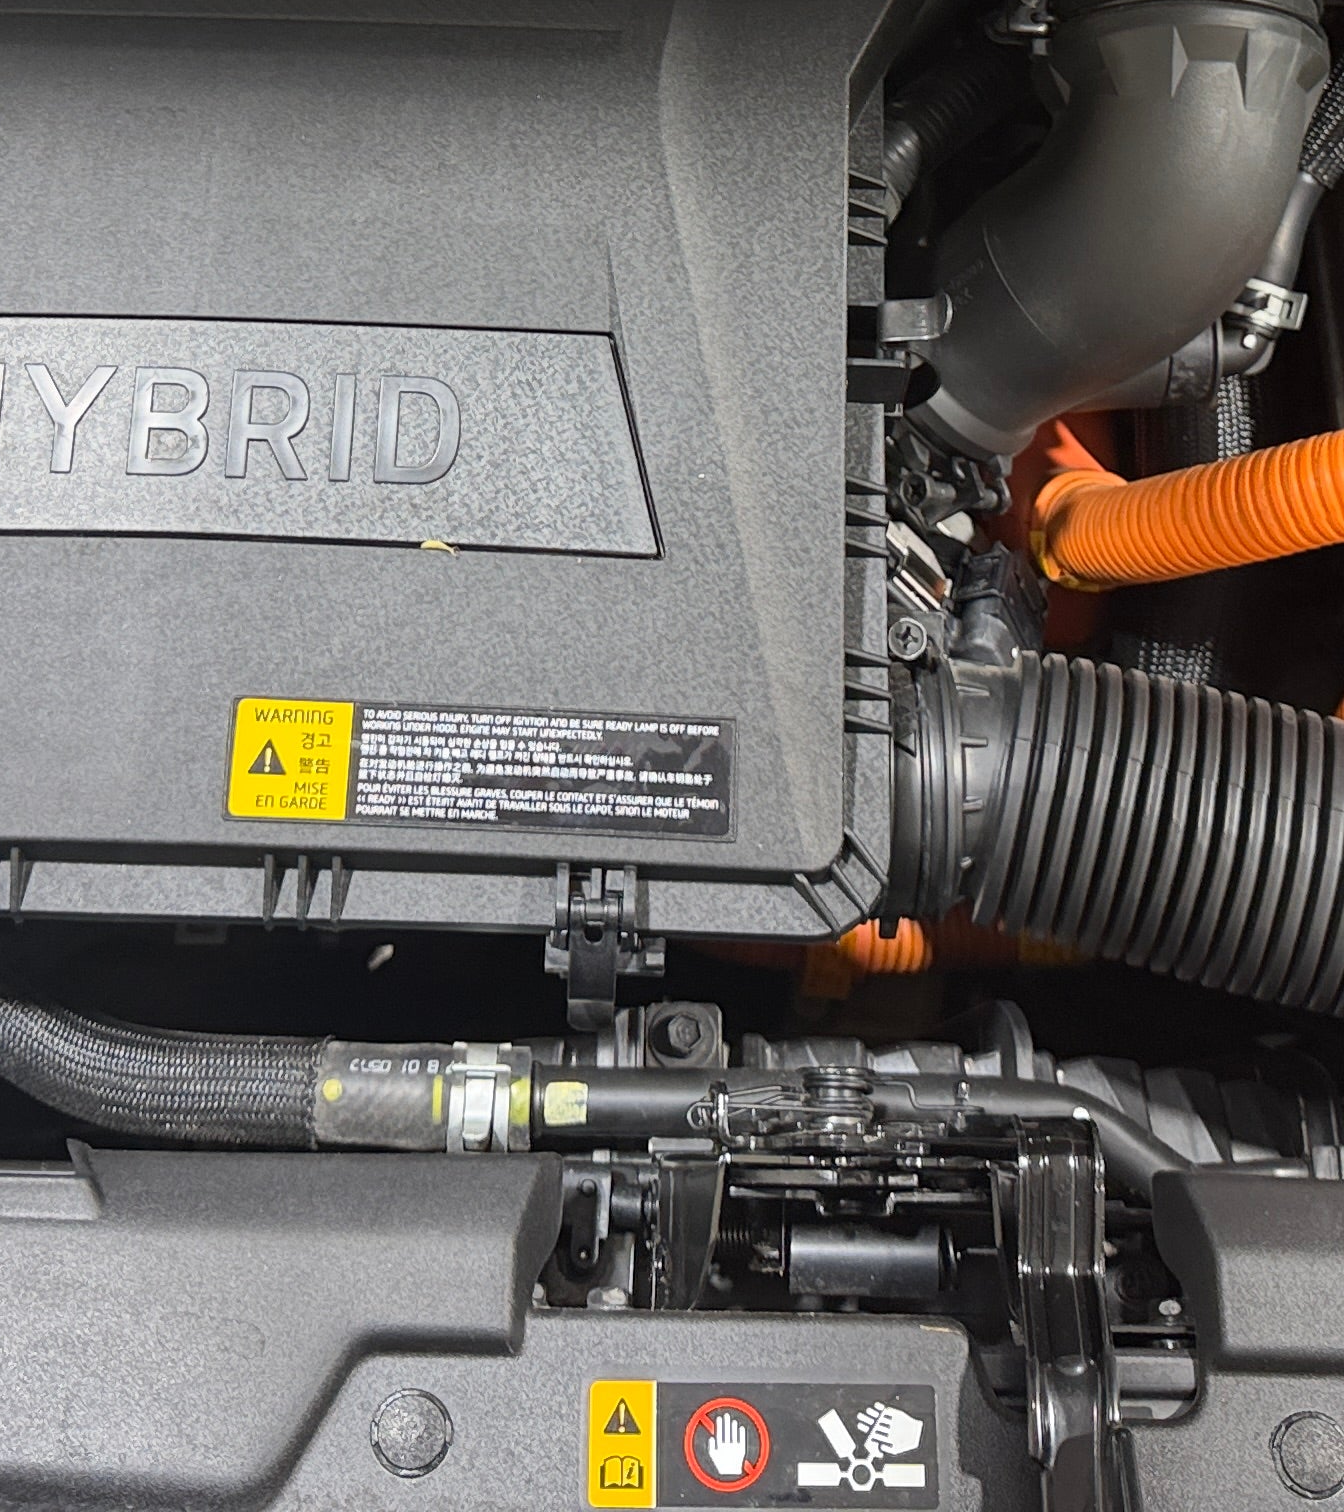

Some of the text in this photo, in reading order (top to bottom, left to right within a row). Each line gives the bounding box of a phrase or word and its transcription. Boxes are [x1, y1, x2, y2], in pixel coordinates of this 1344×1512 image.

[255, 708, 334, 726] WARNING
[363, 708, 375, 719] TO
[376, 709, 401, 720] AVOID
[402, 710, 437, 722] SERIOUS
[470, 714, 493, 724] TURN
[494, 715, 511, 725] OFF
[512, 716, 548, 727] IGNITION
[549, 717, 568, 728] AND
[568, 718, 580, 728] BE
[581, 719, 603, 729] SURE
[605, 720, 633, 731] READY
[634, 721, 658, 732] LAMP
[659, 722, 668, 733] IS
[668, 723, 685, 733] OFF
[686, 724, 719, 735] BEFORE
[361, 720, 401, 731] WORKING
[402, 721, 431, 732] UNDER
[459, 724, 490, 735] ENGINE
[491, 725, 510, 736] MAY
[511, 726, 538, 737] START
[539, 727, 603, 740] UNEXPECTEDLY.
[302, 732, 332, 750] 경고
[299, 757, 331, 775] 警告
[294, 782, 328, 796] MISE
[357, 783, 381, 793] POUR
[381, 781, 412, 794] ÉVITER
[413, 785, 429, 795] LES
[509, 790, 543, 800] COUPER
[544, 791, 555, 801] LE
[556, 792, 594, 803] CONTACT
[595, 793, 606, 803] ET
[607, 794, 653, 805] S'ASSURER
[654, 796, 673, 806] QUE
[673, 797, 685, 807] LE
[685, 795, 719, 808] TÉMOIN
[255, 794, 327, 810] EN GARDE
[355, 804, 397, 816] POURRAIT
[399, 806, 410, 816] SE
[411, 806, 446, 818] METTRE
[447, 808, 460, 818] EN
[367, 794, 395, 804] READY
[407, 796, 424, 806] EST
[425, 795, 455, 807] ÉTEINT
[455, 798, 484, 808] AVANT
[484, 799, 497, 809] DE
[498, 800, 547, 811] TRAVAILLER
[548, 802, 571, 812] SOUS
[572, 803, 584, 813] LE
[614, 805, 640, 816] SINON
[641, 806, 652, 816] LE
[653, 807, 690, 818] MOTEUR
